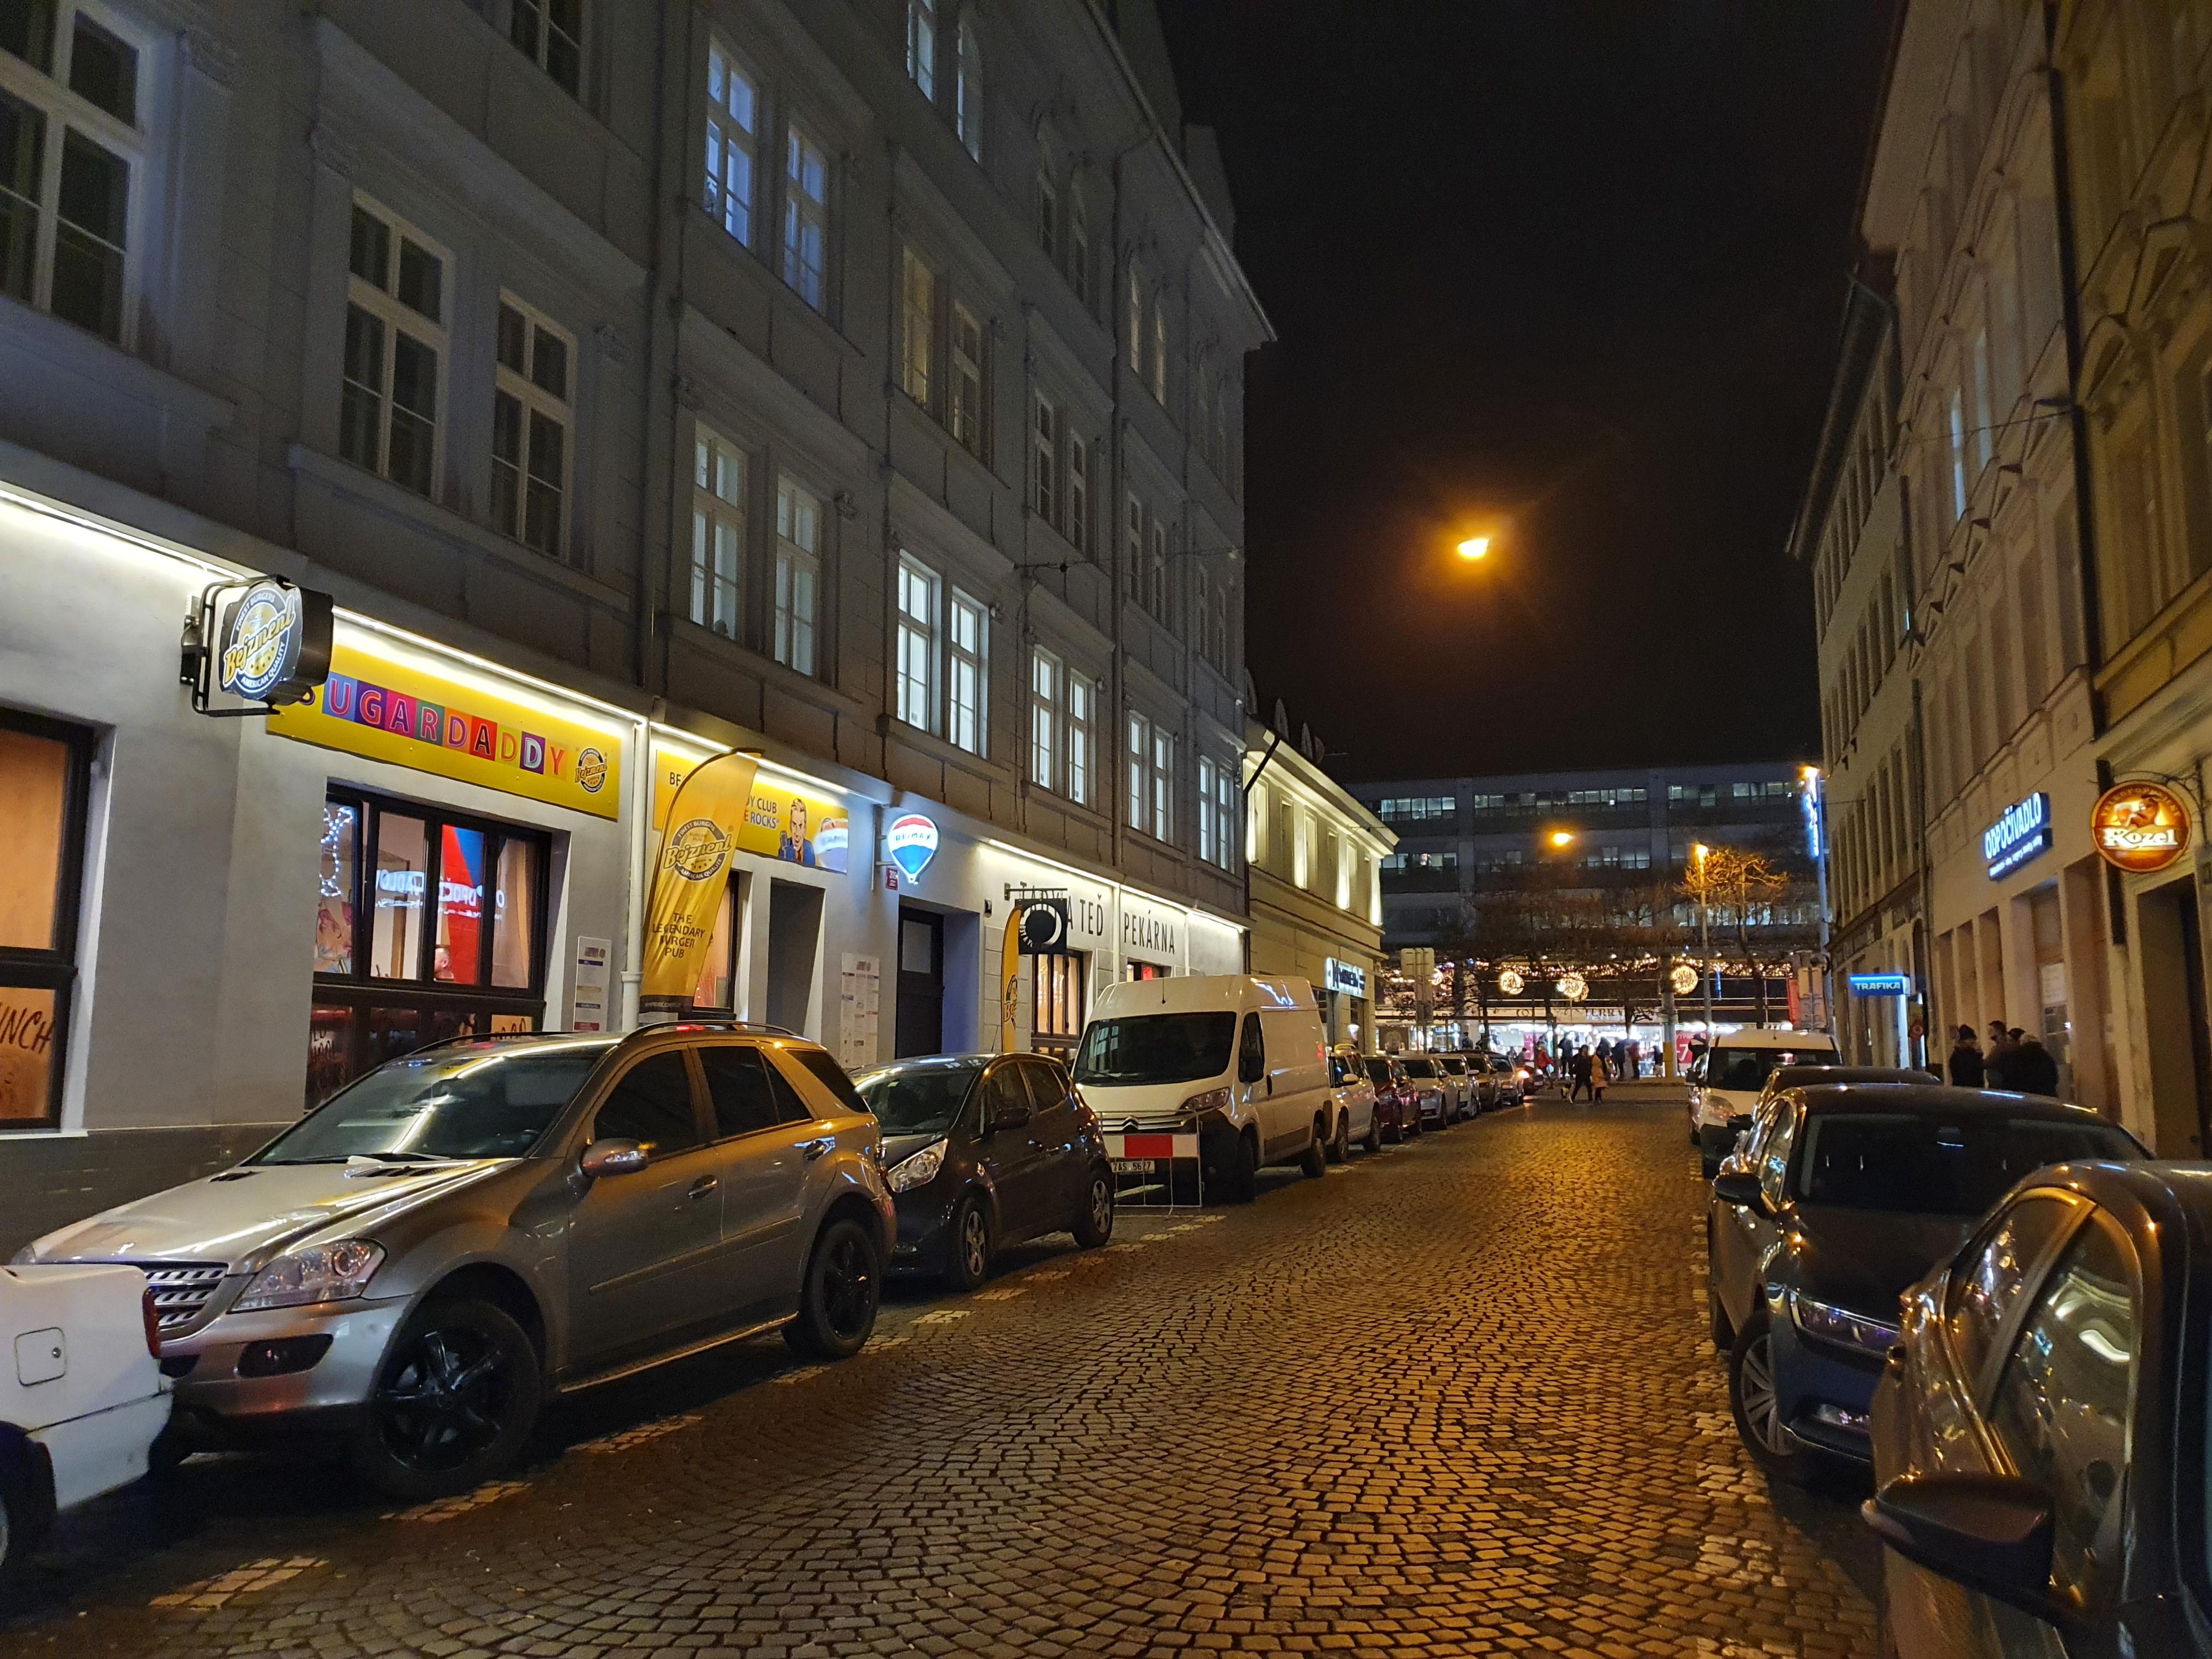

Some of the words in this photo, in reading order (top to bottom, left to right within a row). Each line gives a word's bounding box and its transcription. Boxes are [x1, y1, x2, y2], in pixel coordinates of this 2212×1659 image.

[236, 602, 250, 631] FINEST
[223, 594, 296, 687] Bejzment
[241, 674, 269, 688] AMERICAN
[269, 641, 285, 678] QUALITY
[301, 678, 565, 775] UGARDADDY
[757, 798, 777, 813] CLUB
[1984, 792, 2042, 859] ODPOČÍVADLO
[2103, 828, 2179, 849] Kozel
[680, 868, 703, 879] AMICAN
[703, 858, 722, 877] QUALITY
[673, 912, 692, 922] THE
[1079, 893, 1104, 936] TEĎ
[652, 923, 706, 938] LEGENDARY
[1124, 910, 1175, 954] PEKÁRNA
[664, 947, 685, 958] PUB
[1855, 982, 1901, 990] TRAFIKA
